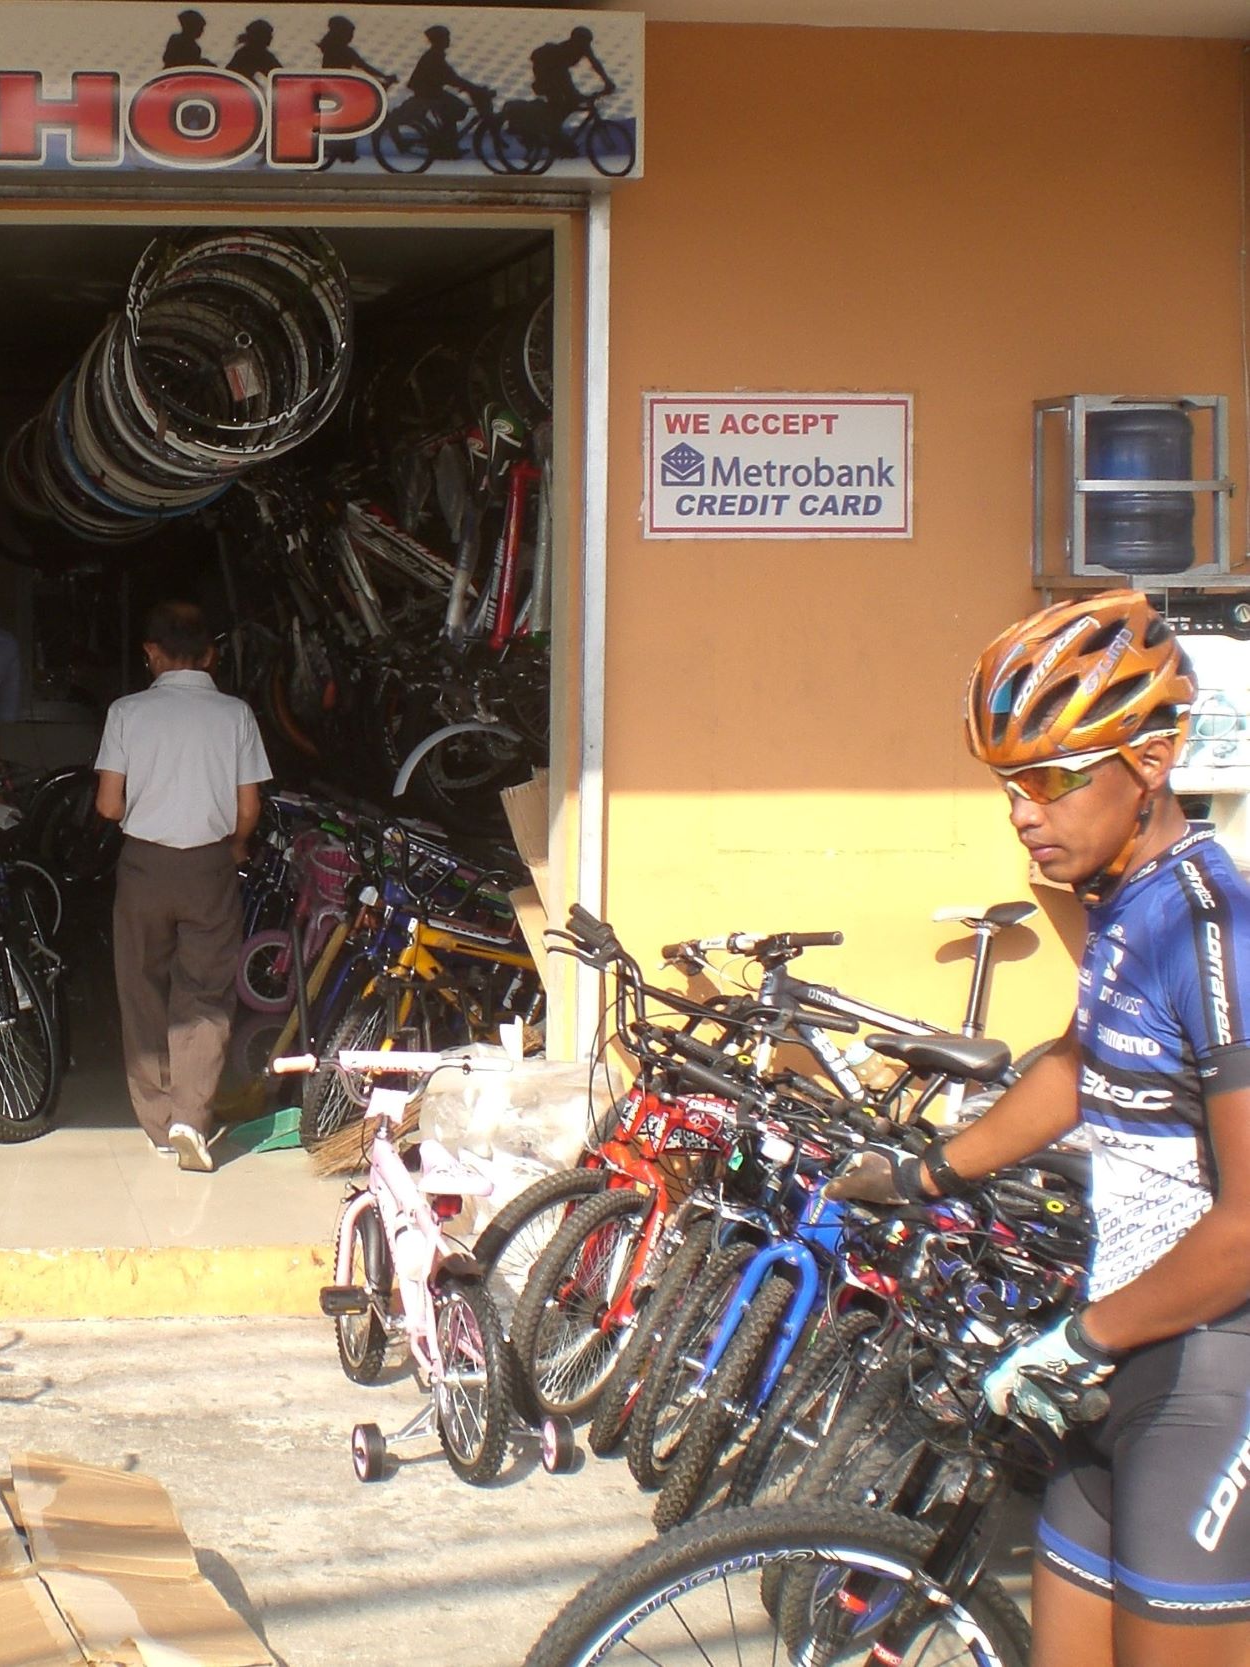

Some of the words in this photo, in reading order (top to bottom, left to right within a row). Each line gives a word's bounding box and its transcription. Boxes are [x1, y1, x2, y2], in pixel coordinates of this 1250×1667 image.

[664, 413, 710, 434] WE
[720, 413, 839, 434] ACCEPT
[711, 456, 895, 487] Metrobank
[675, 494, 791, 516] CREDIT
[799, 494, 883, 516] CARD
[1206, 921, 1233, 1046] corratec
